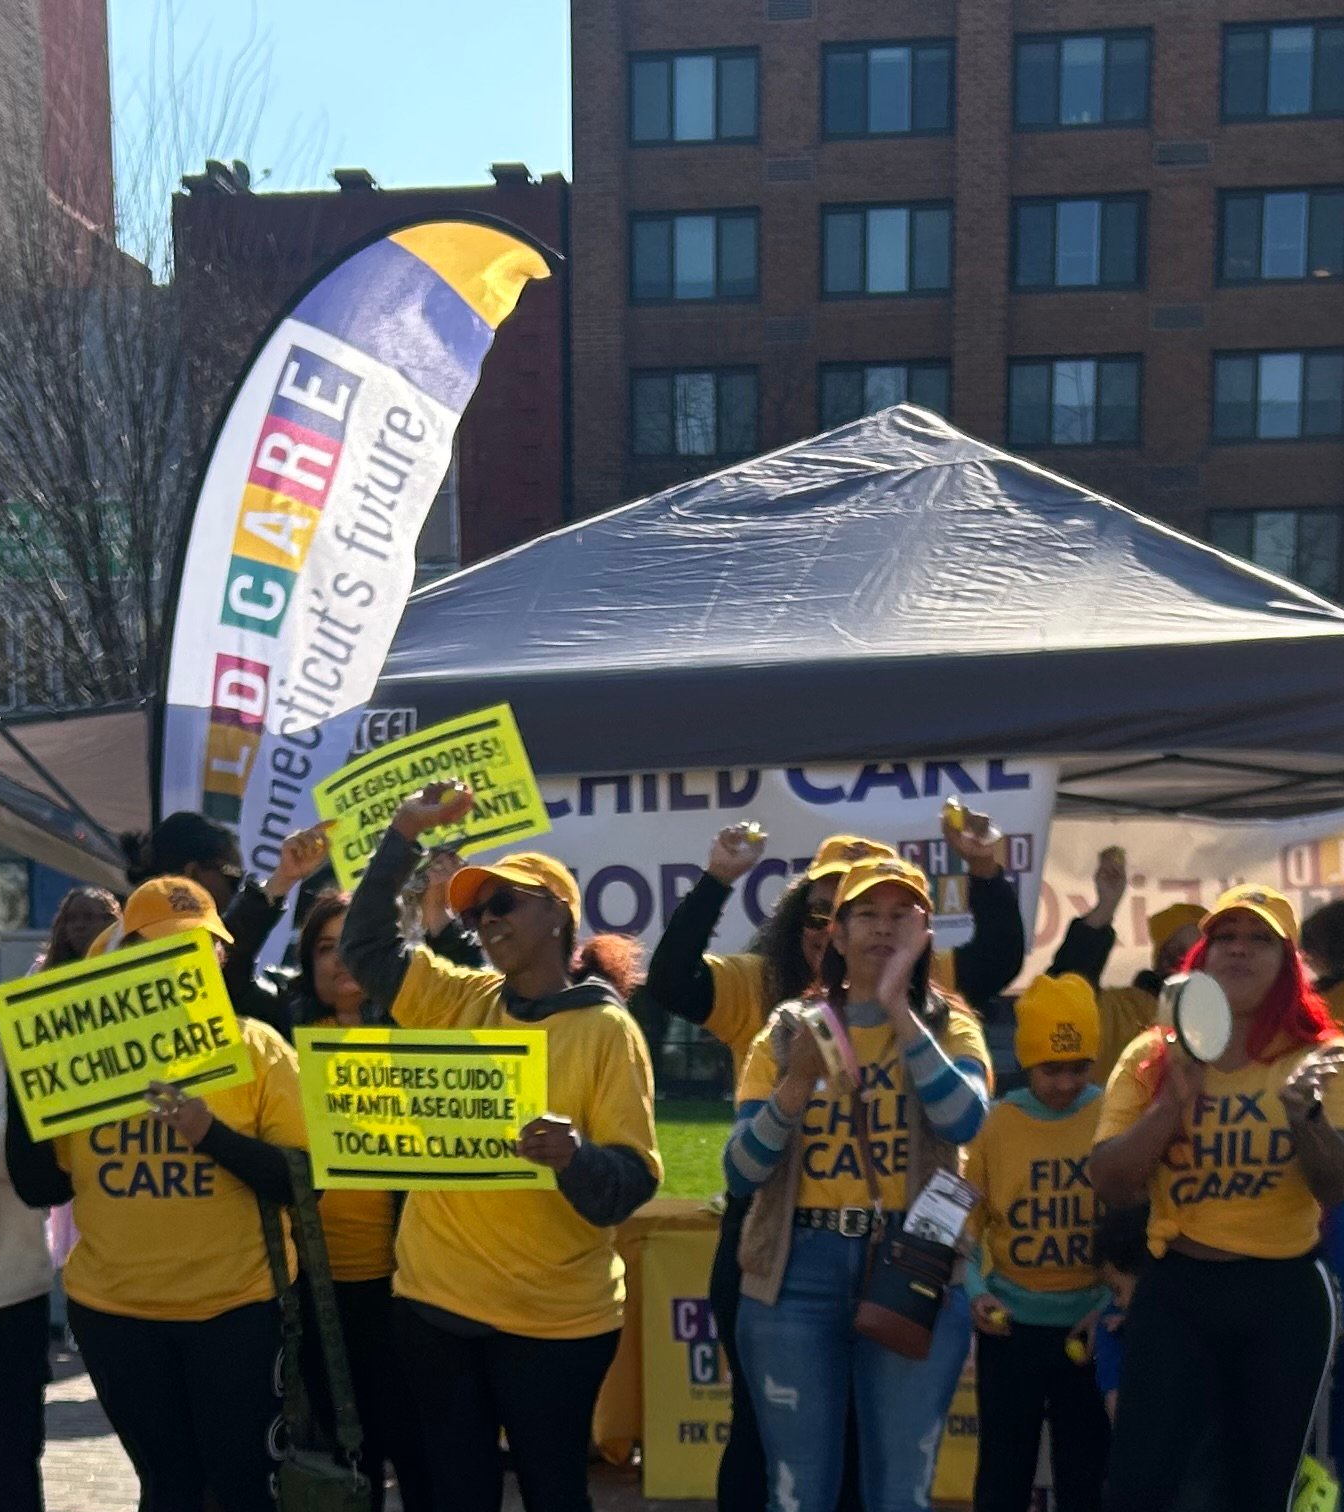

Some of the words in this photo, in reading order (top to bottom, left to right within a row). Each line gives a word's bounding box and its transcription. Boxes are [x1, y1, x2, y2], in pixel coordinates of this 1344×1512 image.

[228, 360, 352, 623] CARE
[246, 572, 376, 884] onnecticut's
[334, 404, 426, 562] future
[470, 790, 529, 822] ANTIL
[14, 967, 209, 1051] LAWMAKERS!
[20, 1061, 68, 1101] FIX
[69, 1039, 148, 1086] CHILD
[151, 1015, 231, 1064] CARE
[858, 1060, 898, 1090] IX
[355, 1066, 439, 1089] QUIERES
[442, 1068, 505, 1091] CUIDO
[325, 1093, 406, 1117] INFANTIL
[409, 1097, 516, 1121] ASEQUIBLE
[1192, 1089, 1268, 1127] FIX
[89, 1117, 198, 1155] CHIL
[333, 1131, 392, 1157] TOCA
[395, 1134, 423, 1157] EL
[425, 1136, 520, 1160] CLAXON
[1160, 1128, 1298, 1172] CHILD
[803, 1137, 907, 1181] CARE
[1030, 1156, 1094, 1191] FIX
[98, 1160, 217, 1199] CARE
[1009, 1233, 1093, 1268] CAR
[678, 1421, 710, 1444] FIX
